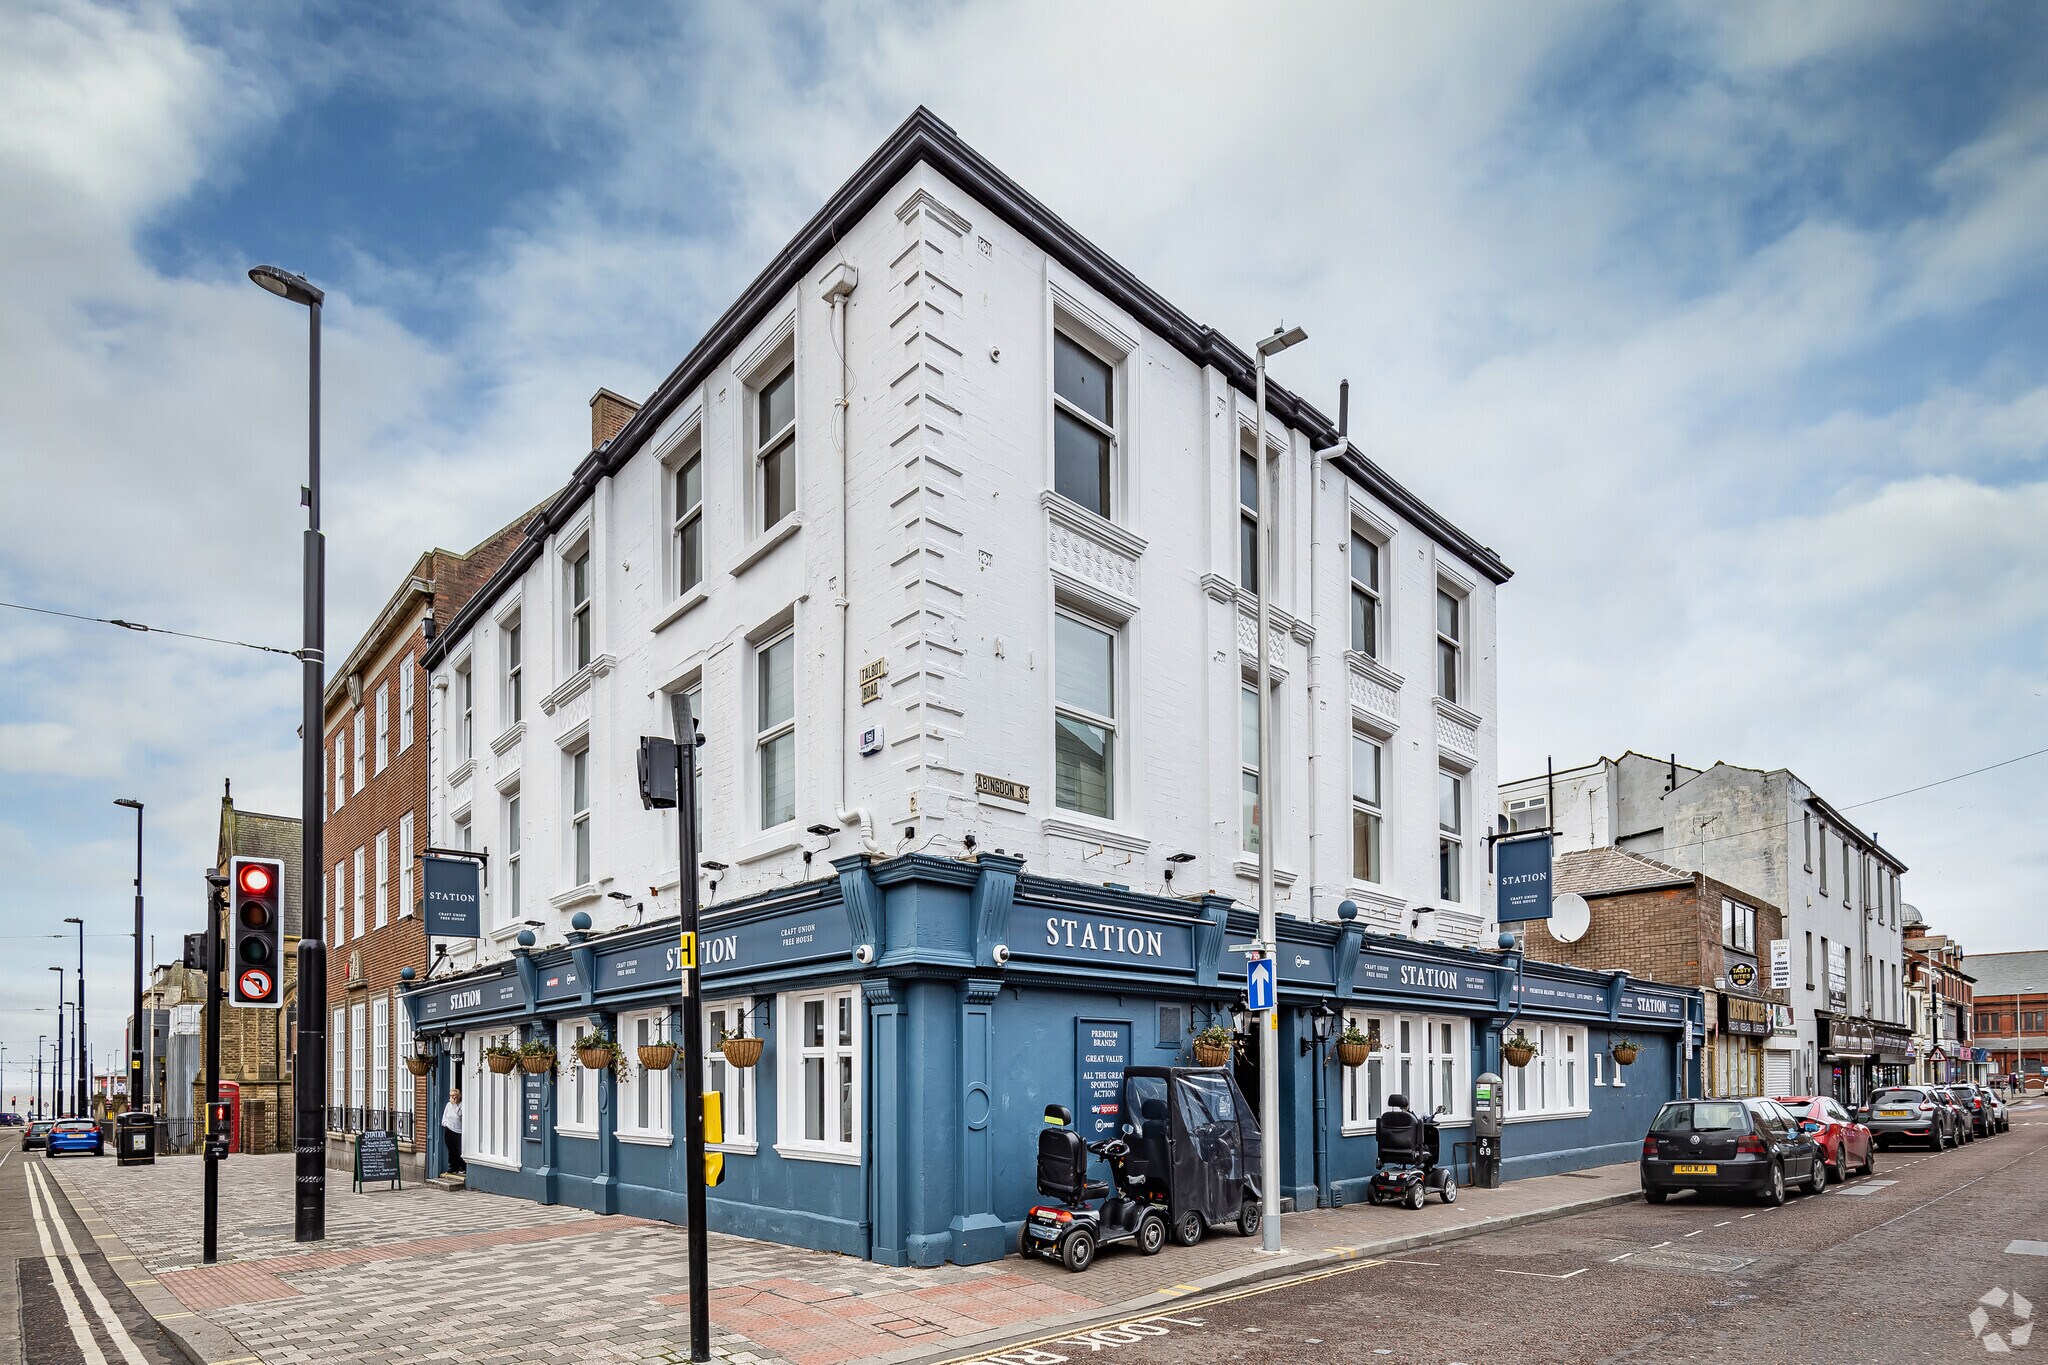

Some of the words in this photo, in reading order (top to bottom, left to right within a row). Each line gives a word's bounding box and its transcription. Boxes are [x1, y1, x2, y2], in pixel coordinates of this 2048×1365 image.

[862, 661, 882, 682] TALBOT
[864, 682, 878, 699] ROAD
[978, 776, 1014, 797] ABINGDON
[1502, 872, 1547, 885] STATION
[430, 892, 475, 902] STATION
[780, 927, 796, 937] CRAFT
[798, 924, 816, 934] UNION
[1046, 917, 1162, 957] STATION
[782, 938, 794, 946] FREE
[796, 935, 813, 944] HOUSE
[666, 935, 738, 972] STTION
[1400, 965, 1458, 990] STATION
[450, 989, 481, 1010] STATION
[1637, 997, 1666, 1013] STATION
[1729, 998, 1748, 1020] TASTY
[1092, 1030, 1118, 1038] PREMIUM
[365, 1130, 386, 1139] STATION
[1480, 1147, 1491, 1156] 69
[1058, 1316, 1203, 1351] LOOK
